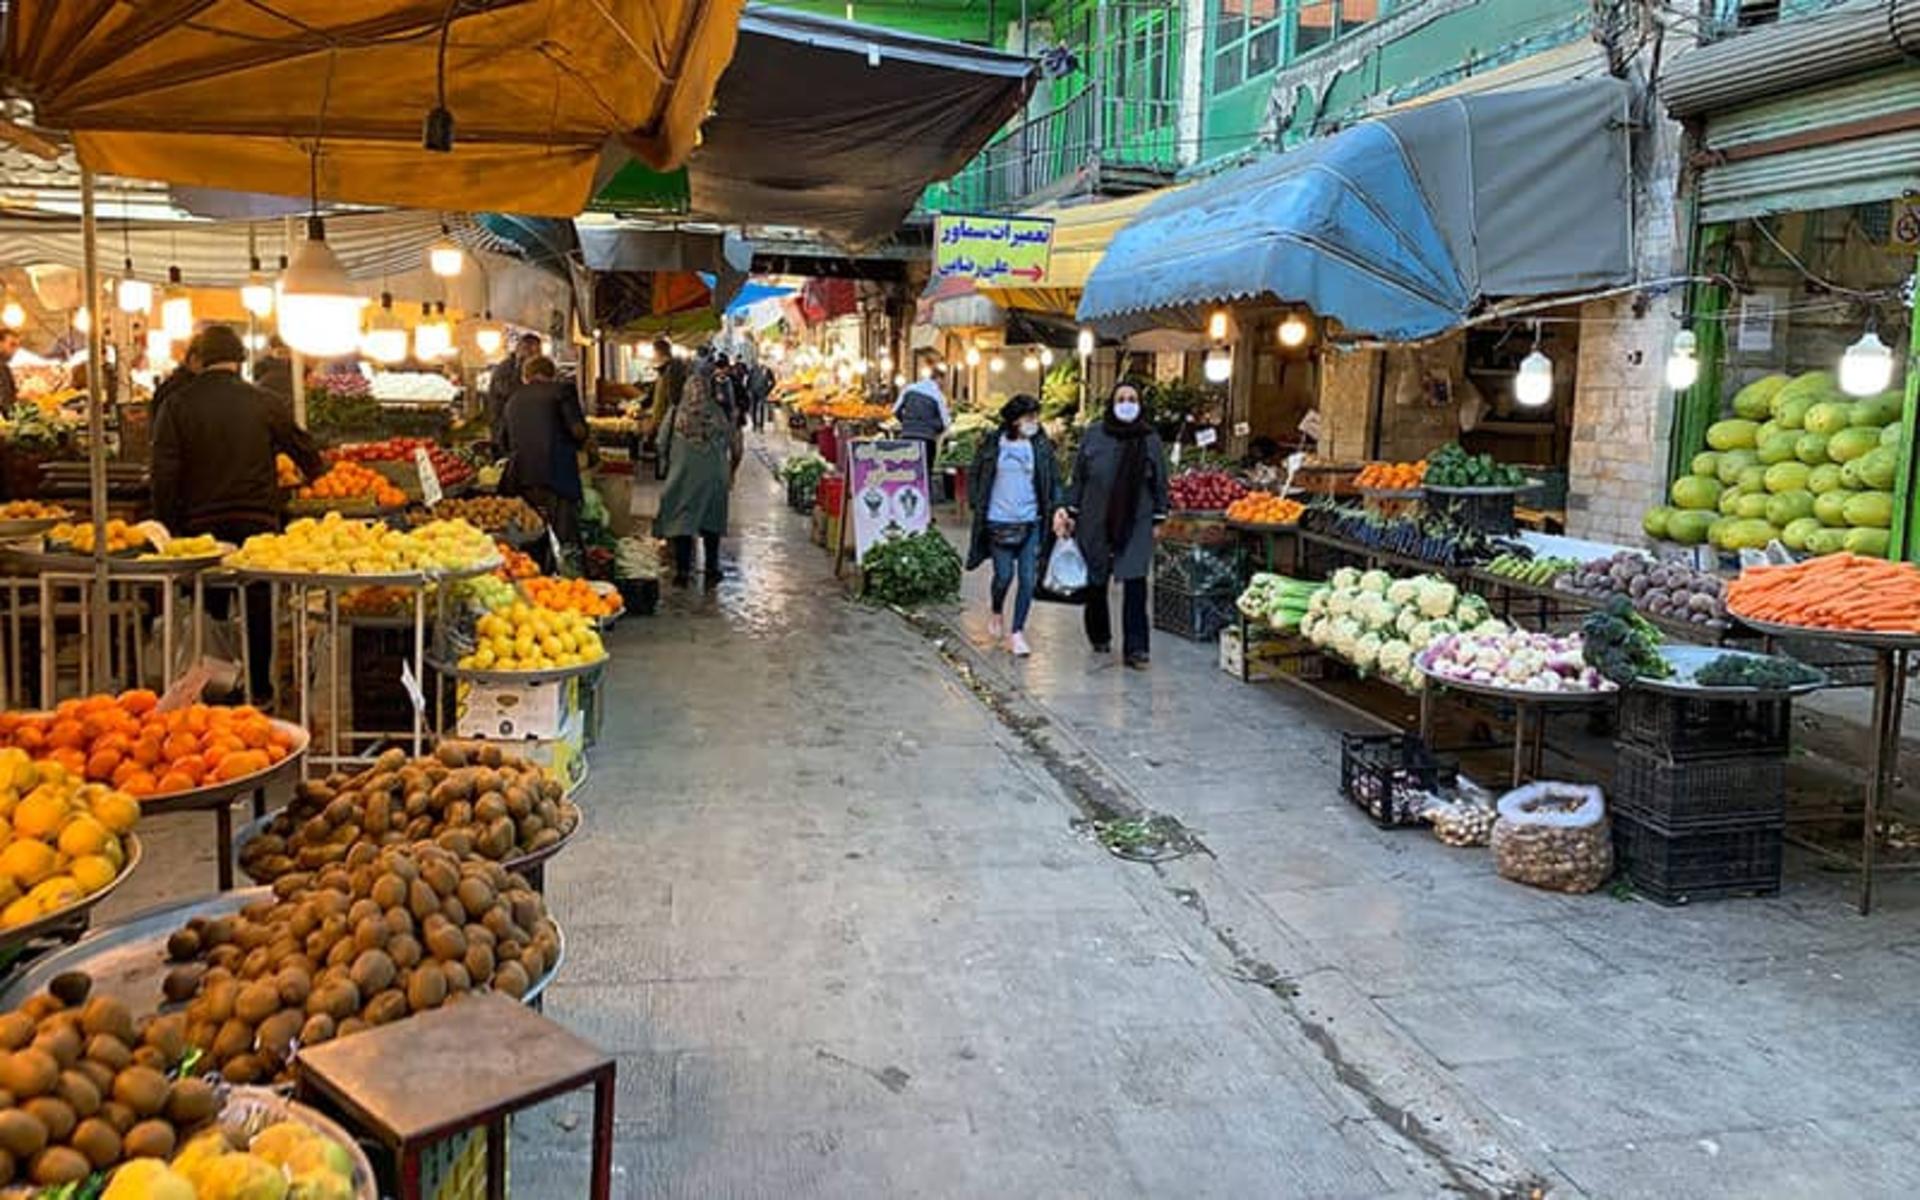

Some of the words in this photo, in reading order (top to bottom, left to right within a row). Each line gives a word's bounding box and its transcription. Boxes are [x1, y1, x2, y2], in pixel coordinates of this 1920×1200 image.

[941, 219, 989, 245] سماور
[990, 222, 1049, 248] تعمیرات
[981, 256, 1008, 283] علی
